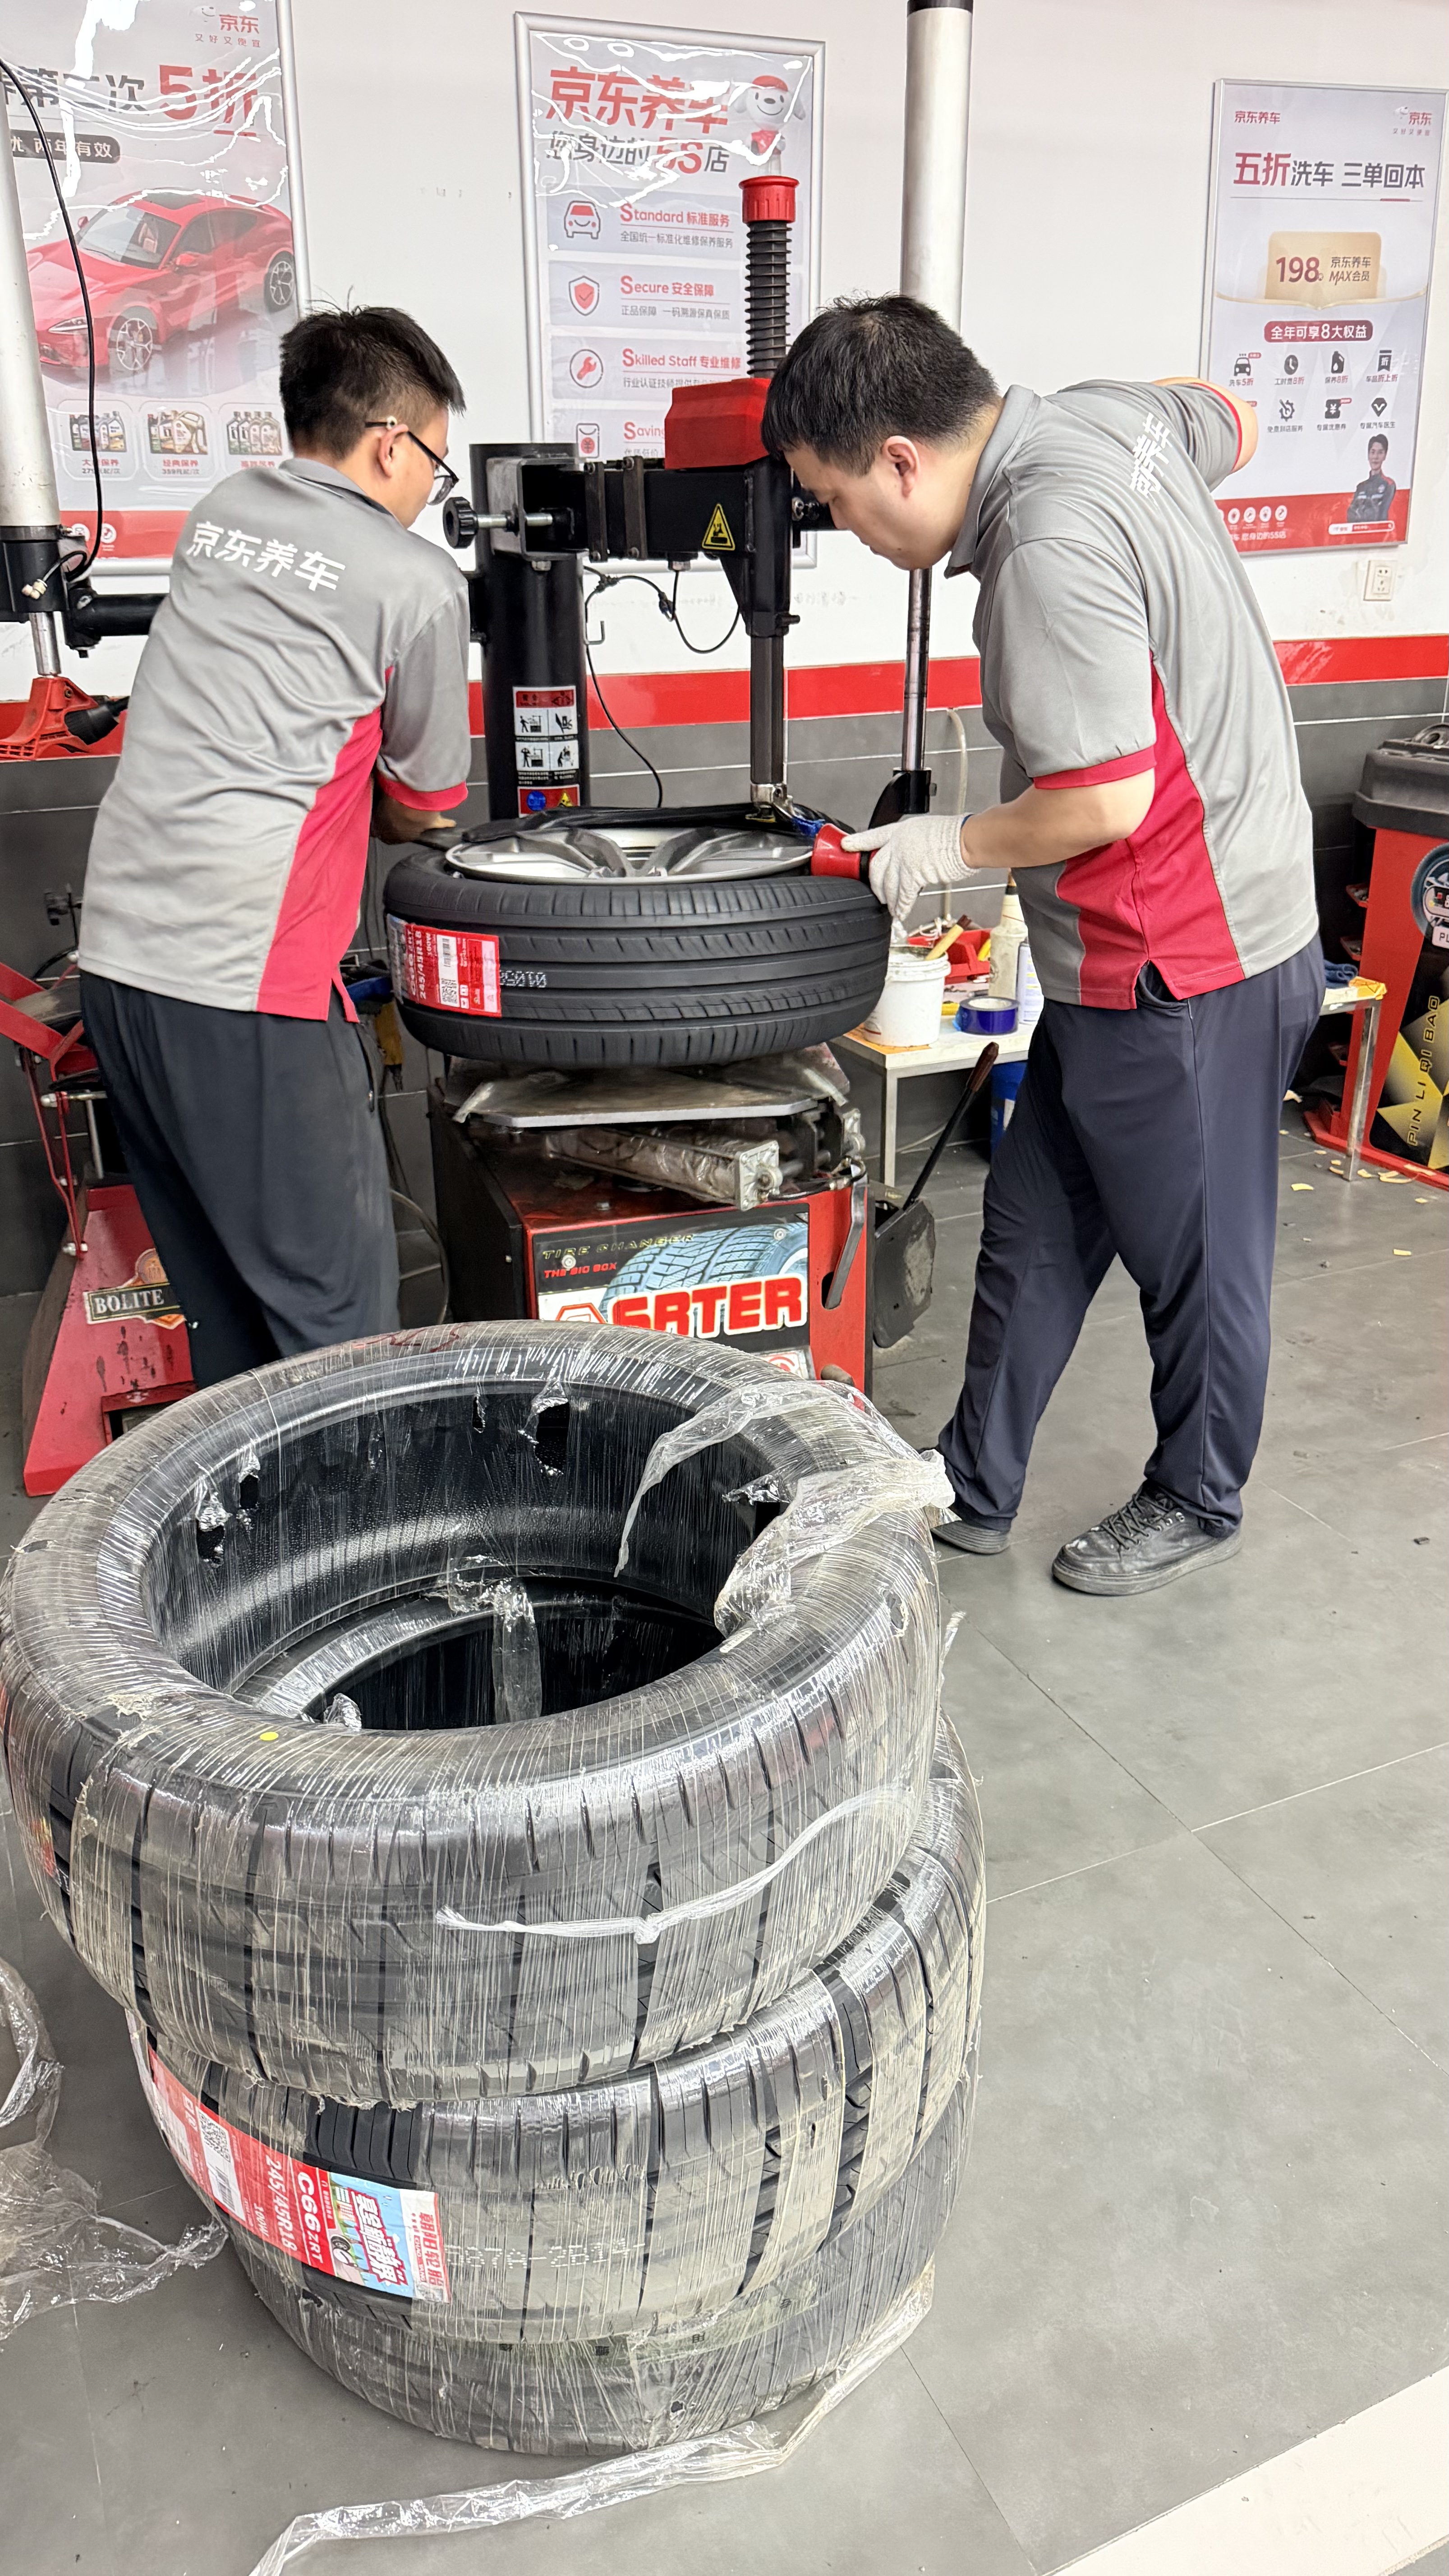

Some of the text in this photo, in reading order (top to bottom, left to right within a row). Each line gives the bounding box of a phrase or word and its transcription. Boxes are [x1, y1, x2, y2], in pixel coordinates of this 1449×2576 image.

[219, 14, 259, 34] 京东
[1, 66, 150, 116] 第二次
[546, 66, 728, 134] 京东养车
[1234, 111, 1280, 124] 京东养车
[1408, 112, 1432, 125] 京东
[1233, 152, 1425, 189] 五折洗车 三单回本
[620, 203, 730, 227] Standard 标准服务
[1276, 257, 1320, 283] 198
[1330, 257, 1371, 268] 京东养车
[620, 275, 714, 296] Secure 安全保障
[1329, 271, 1370, 285] MAX会员
[621, 305, 657, 317] 正品保障
[1271, 324, 1367, 340] 全年可享8大权益
[622, 348, 741, 369] Skilled Staff 专业维修
[82, 459, 119, 467] 大保养
[186, 520, 346, 592] 京东养车
[1407, 995, 1441, 1146] PIN LI QI BAO
[543, 1246, 590, 1260] TIRE
[593, 1262, 617, 1272] BOX
[94, 1289, 164, 1314] BOLITE
[266, 2154, 298, 2252] 245/45R18
[253, 2203, 269, 2237] 100W
